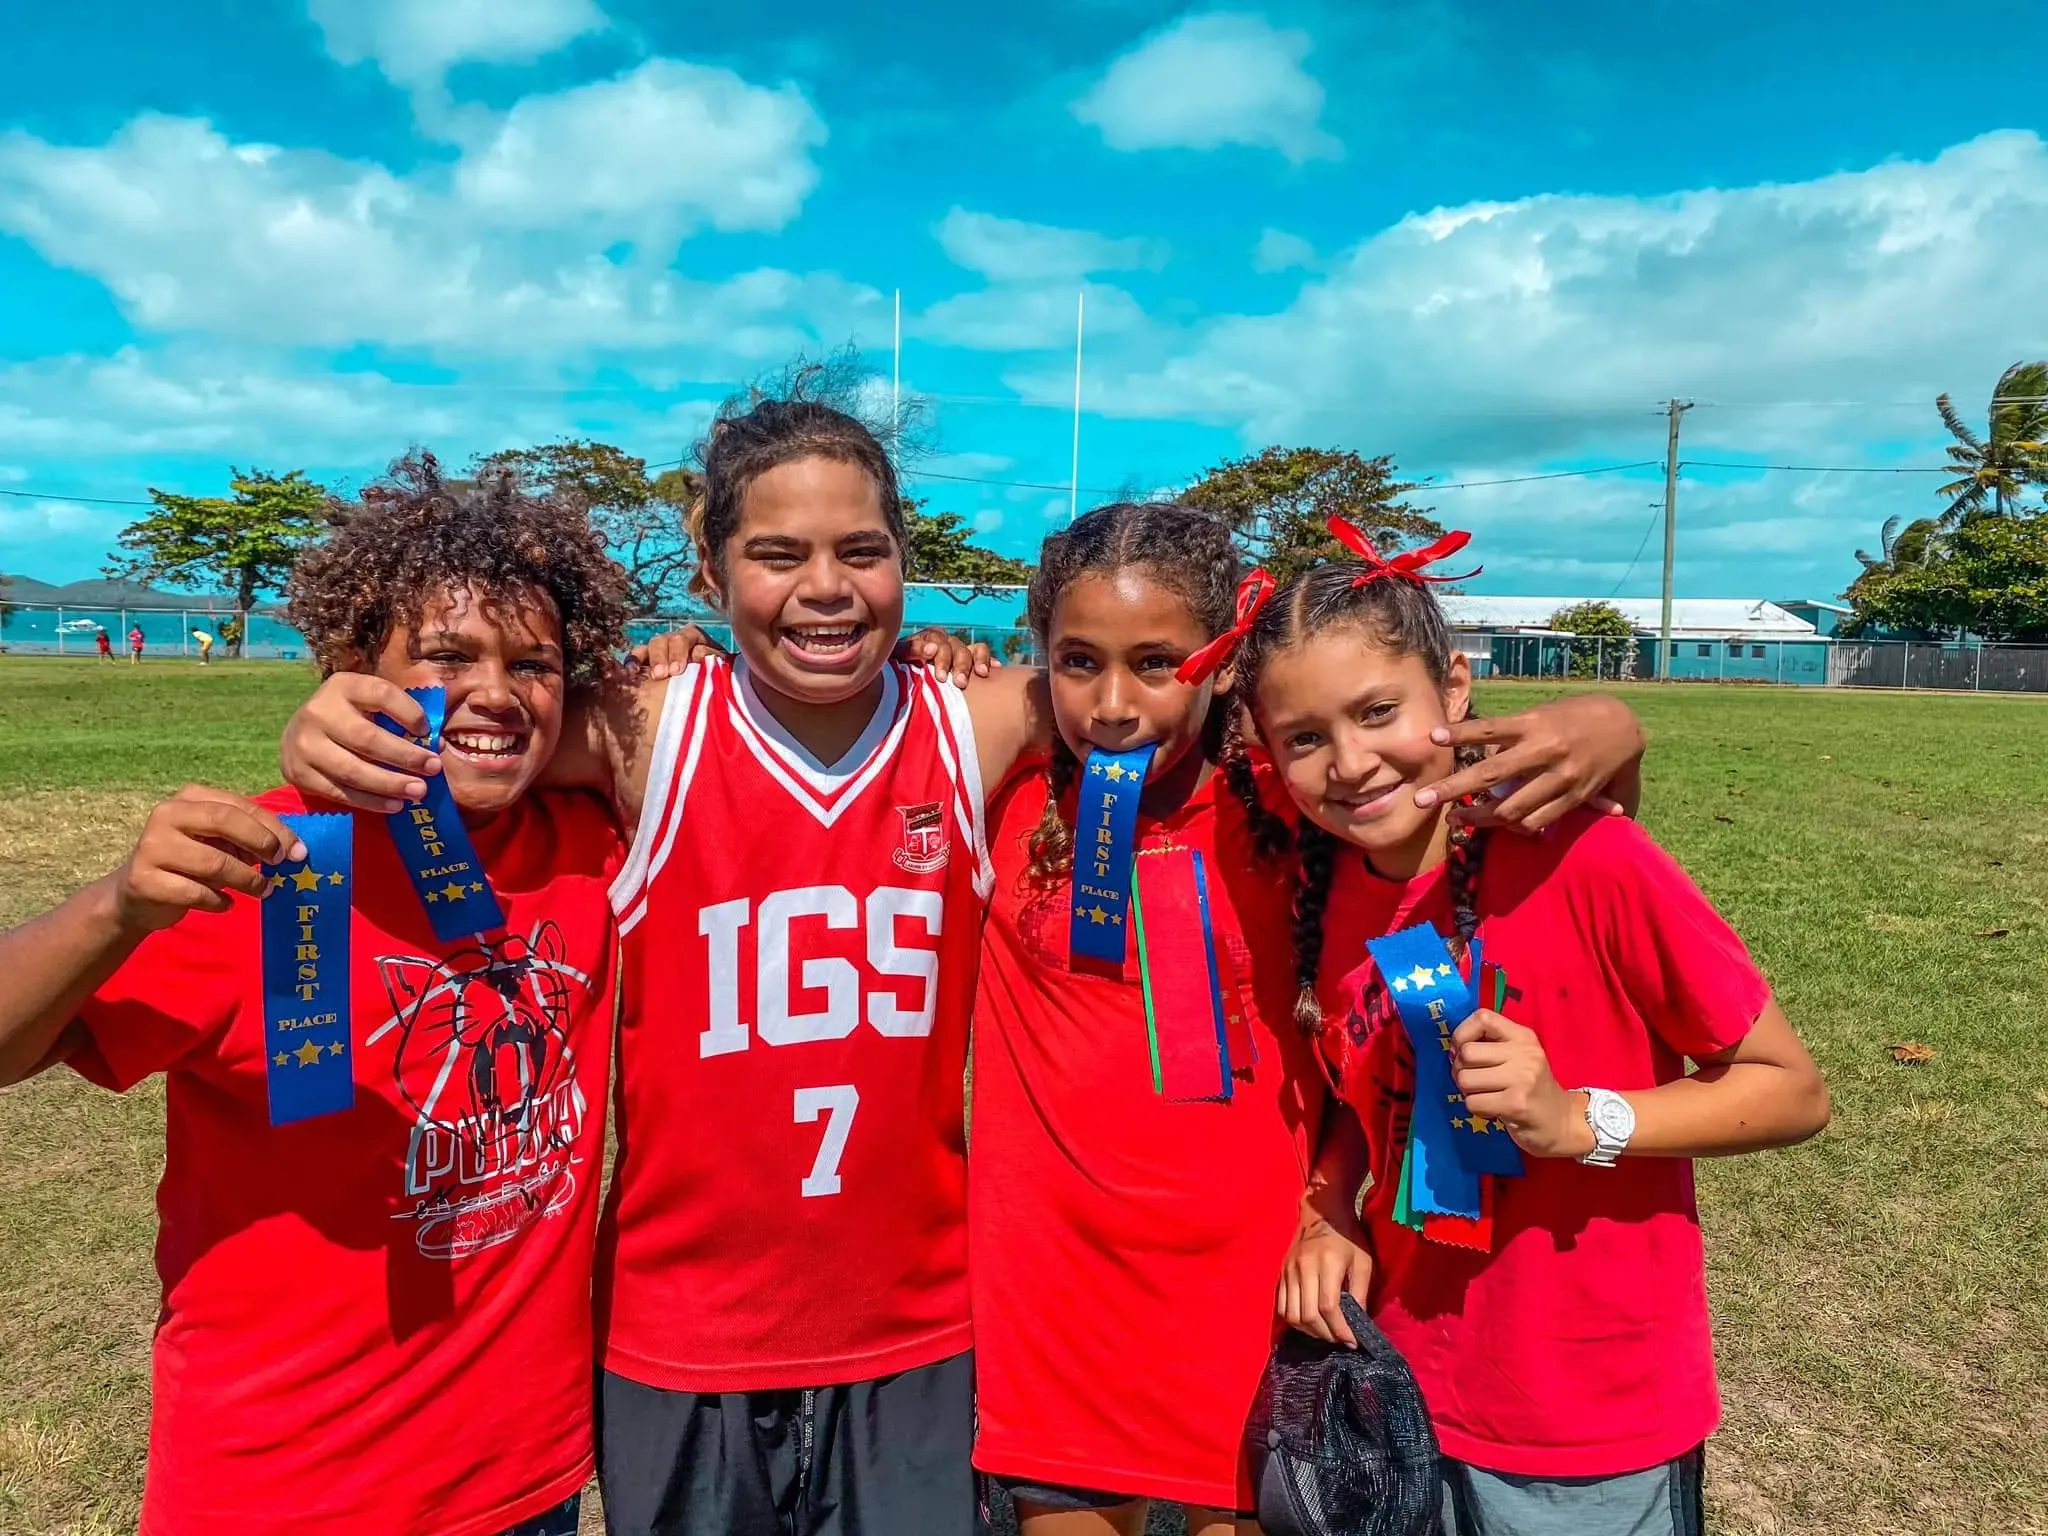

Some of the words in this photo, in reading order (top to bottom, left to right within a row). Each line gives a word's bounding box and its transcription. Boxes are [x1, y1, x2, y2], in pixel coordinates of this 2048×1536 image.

[409, 799, 446, 857] RST
[1093, 792, 1118, 878] FIRST
[420, 861, 470, 879] PLACE
[1079, 883, 1120, 900] PLACE
[295, 904, 321, 1001] FIRST
[698, 884, 944, 1060] IGS
[277, 1012, 338, 1032] PLACE
[793, 1083, 861, 1198] 7
